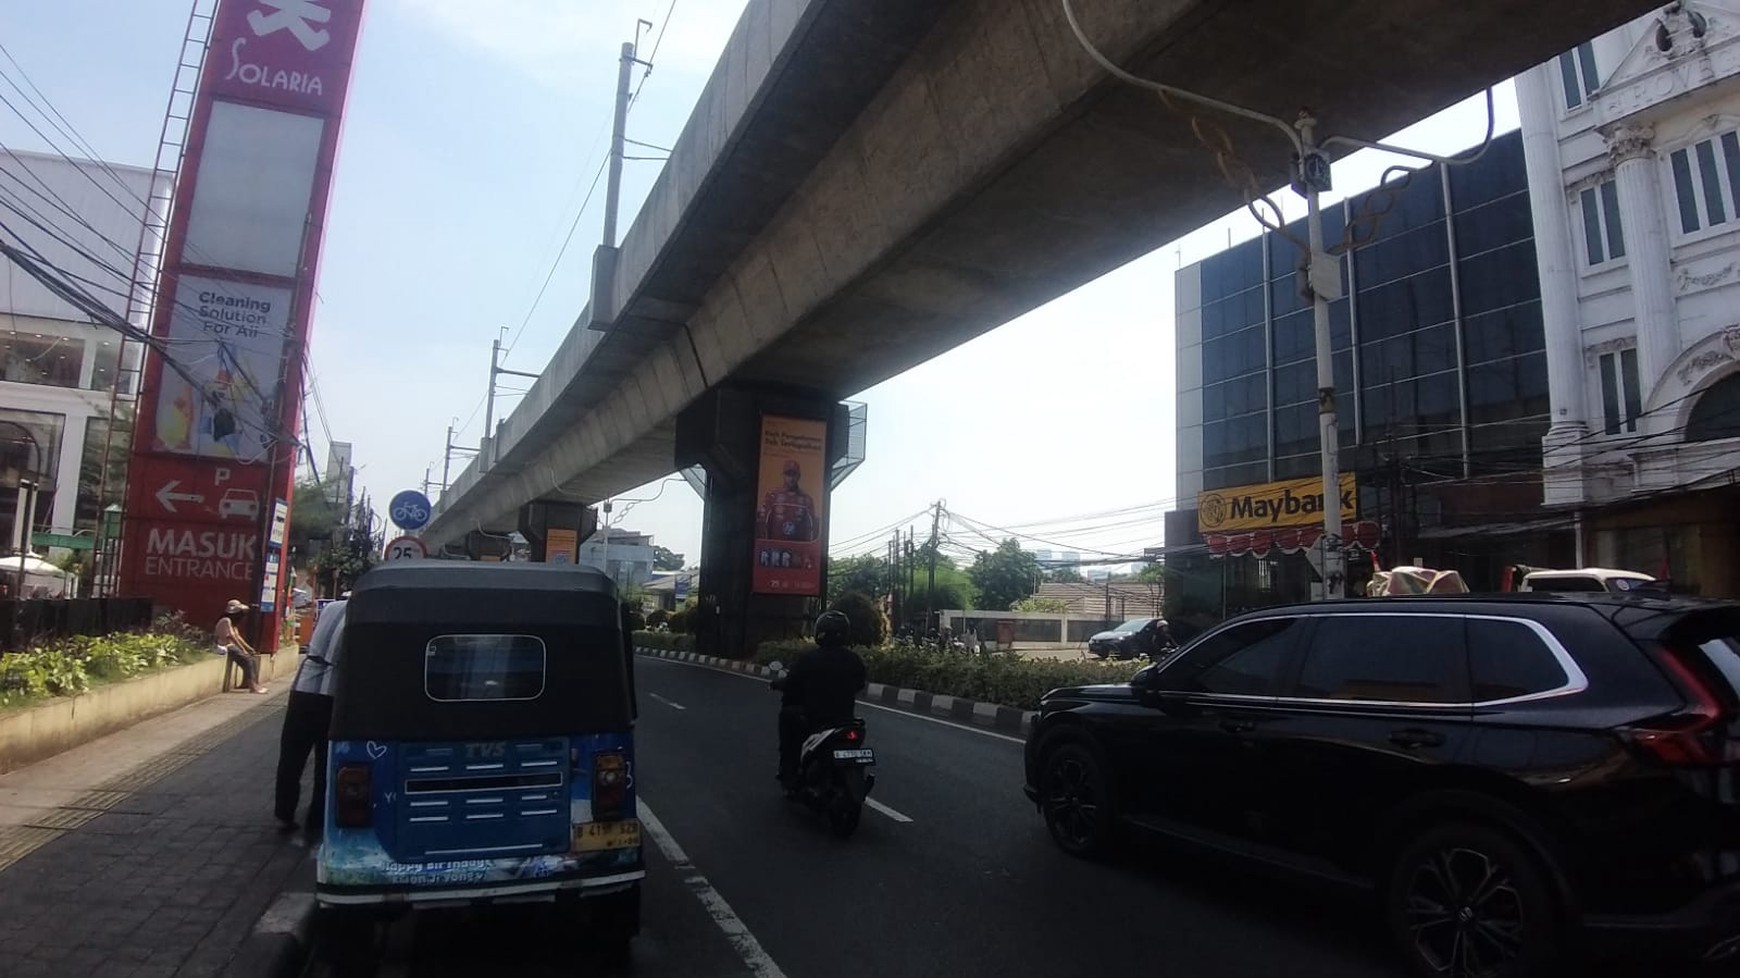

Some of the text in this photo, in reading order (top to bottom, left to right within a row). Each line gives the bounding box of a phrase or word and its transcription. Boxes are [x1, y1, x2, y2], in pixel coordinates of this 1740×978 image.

[226, 37, 323, 96] SOLARIA
[199, 291, 271, 313] Cleaning
[200, 305, 267, 324] Solution
[203, 321, 230, 335] For
[214, 468, 231, 486] P
[146, 528, 257, 560] MASUK
[145, 557, 254, 580] ENTRANCE
[464, 742, 506, 759] TVS
